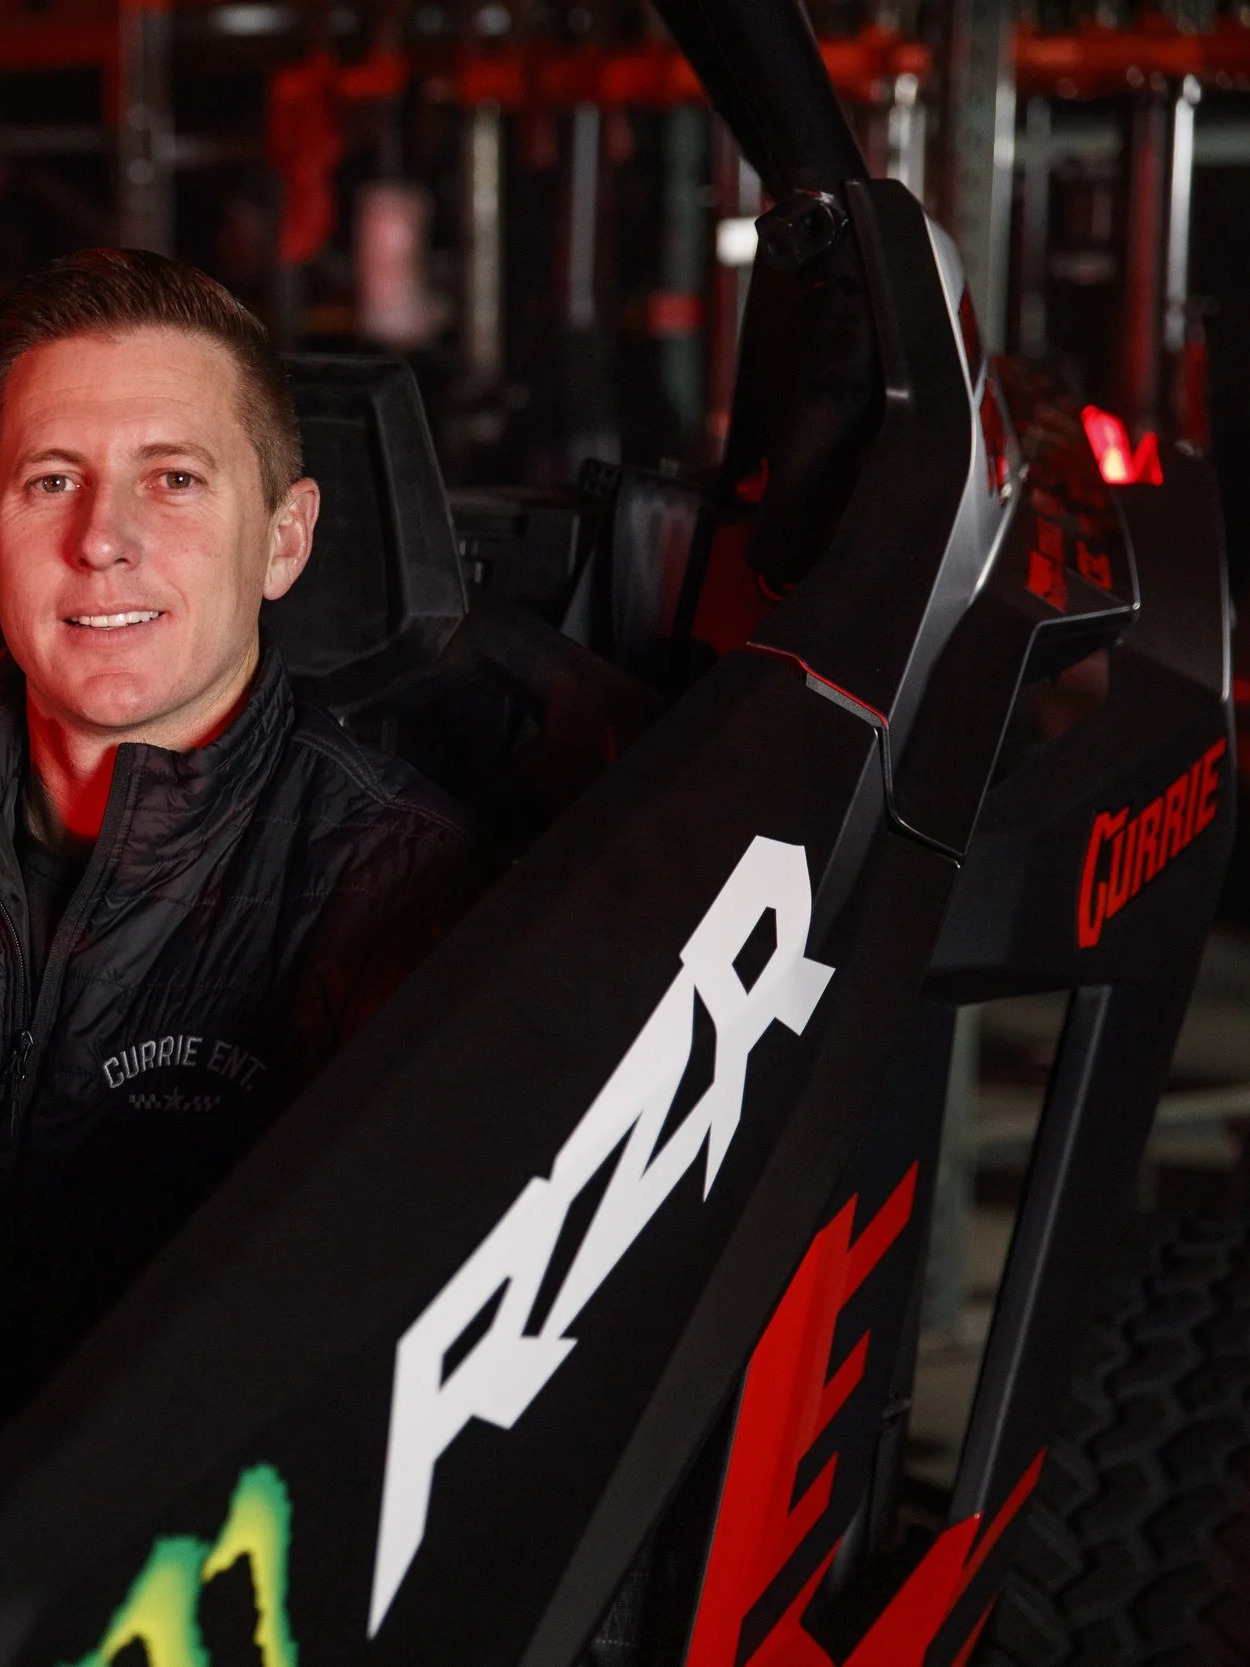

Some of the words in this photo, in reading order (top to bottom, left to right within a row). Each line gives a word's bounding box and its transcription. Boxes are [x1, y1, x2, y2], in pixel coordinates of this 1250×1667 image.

[1077, 737, 1227, 949] CURRIE
[102, 1034, 203, 1089] CURRIE
[206, 1038, 268, 1092] ENT.
[367, 834, 837, 1641] RZR
